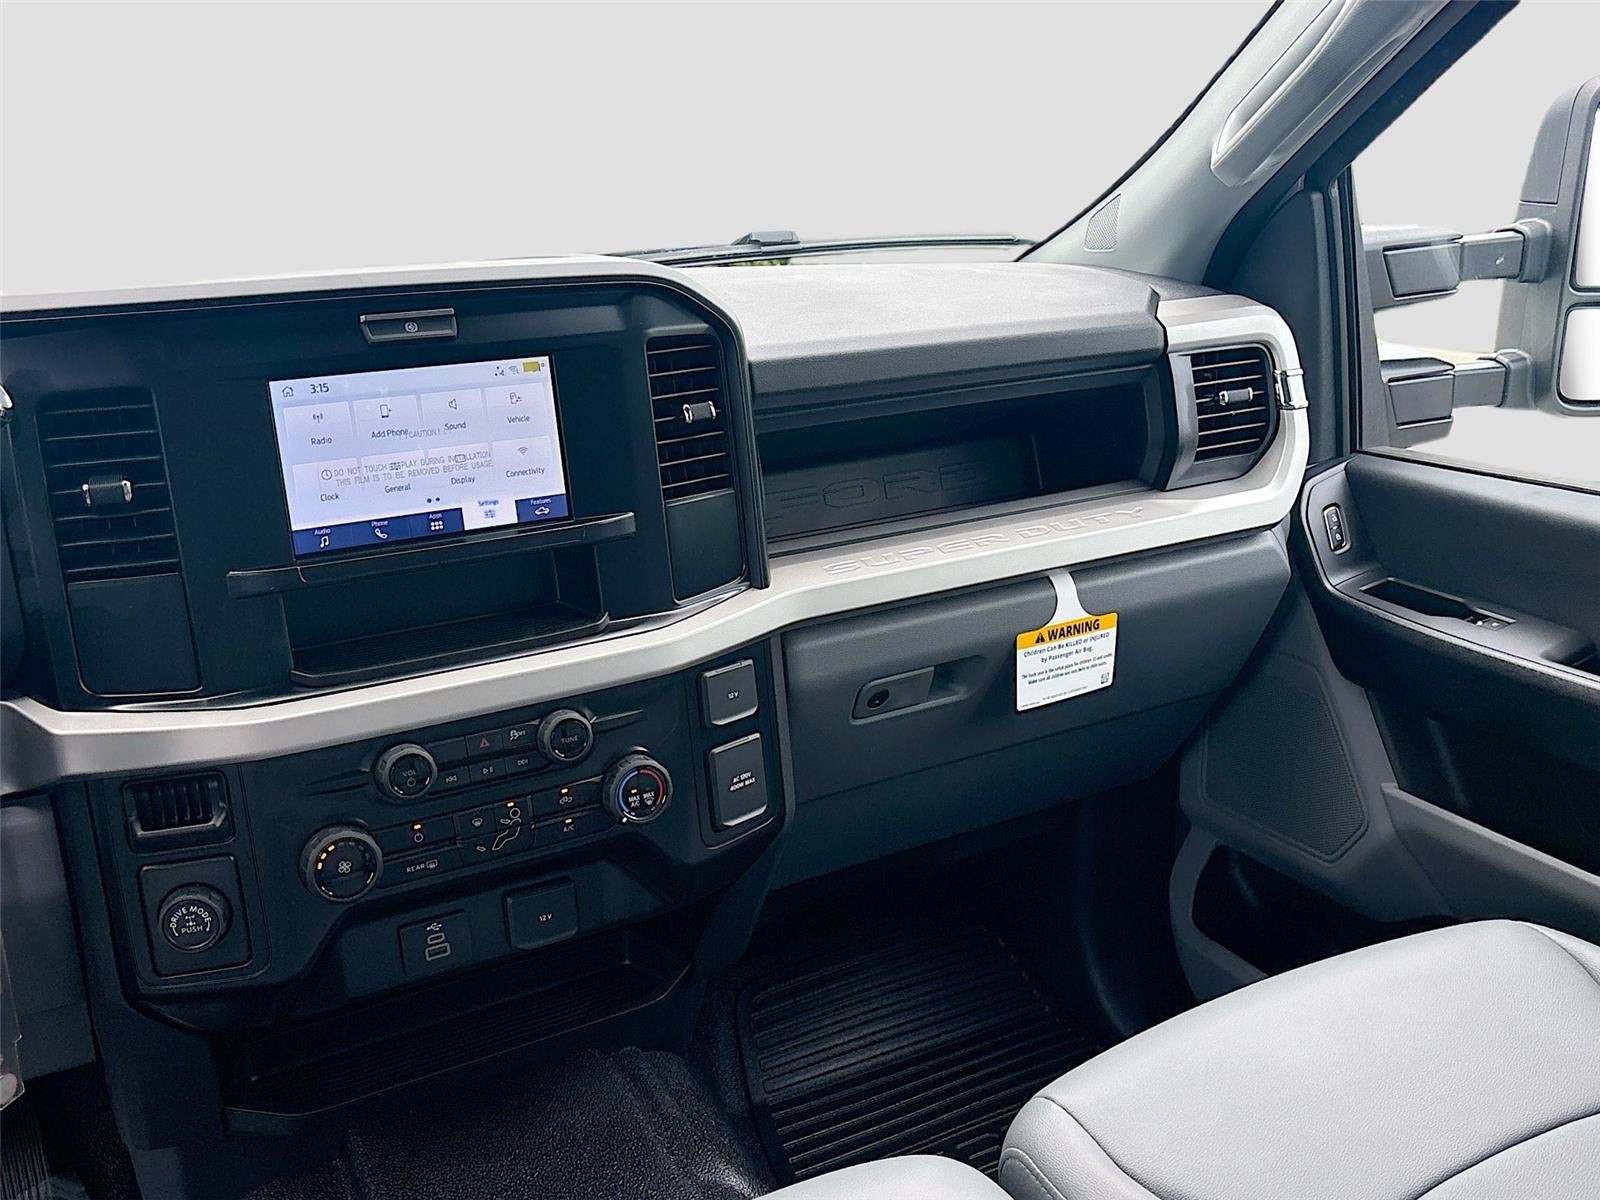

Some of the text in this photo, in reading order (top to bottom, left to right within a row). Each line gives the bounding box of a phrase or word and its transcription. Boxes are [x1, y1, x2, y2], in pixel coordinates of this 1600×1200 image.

[310, 383, 329, 394] 3:15
[507, 414, 530, 423] Vehicle
[444, 421, 466, 431] Sound
[371, 428, 409, 439] Add Phone
[409, 429, 437, 438] CAUTION
[310, 436, 332, 445] Radio
[334, 469, 344, 477] DO
[347, 466, 361, 475] NOT
[364, 464, 387, 472] TOUCH
[389, 460, 417, 470] SPLAY
[420, 456, 445, 466] DURING
[336, 478, 351, 487] THIS
[354, 475, 370, 485] FILM
[373, 474, 380, 482] IS
[396, 471, 405, 479] BE
[408, 467, 439, 477] REMOVED
[443, 463, 468, 473] BEFORE
[505, 466, 545, 479] Connectivity
[451, 476, 475, 485] Display
[384, 483, 411, 493] General
[320, 492, 339, 501] Clock
[478, 499, 499, 507] Settings
[428, 513, 443, 521] Apps
[823, 506, 1144, 576] SUPER DUTY
[1048, 619, 1100, 641] WARNING
[1024, 647, 1046, 658] Children
[1065, 638, 1082, 648] KILLED
[1048, 650, 1074, 661] Passenger
[561, 735, 578, 743] TUNE
[402, 769, 416, 777] VOL
[732, 775, 740, 783] AC
[744, 776, 756, 786] MAX
[643, 791, 655, 799] MAX
[406, 863, 425, 873] REAR
[170, 905, 212, 928] DRIVE MODE
[181, 925, 203, 934] PUSH
